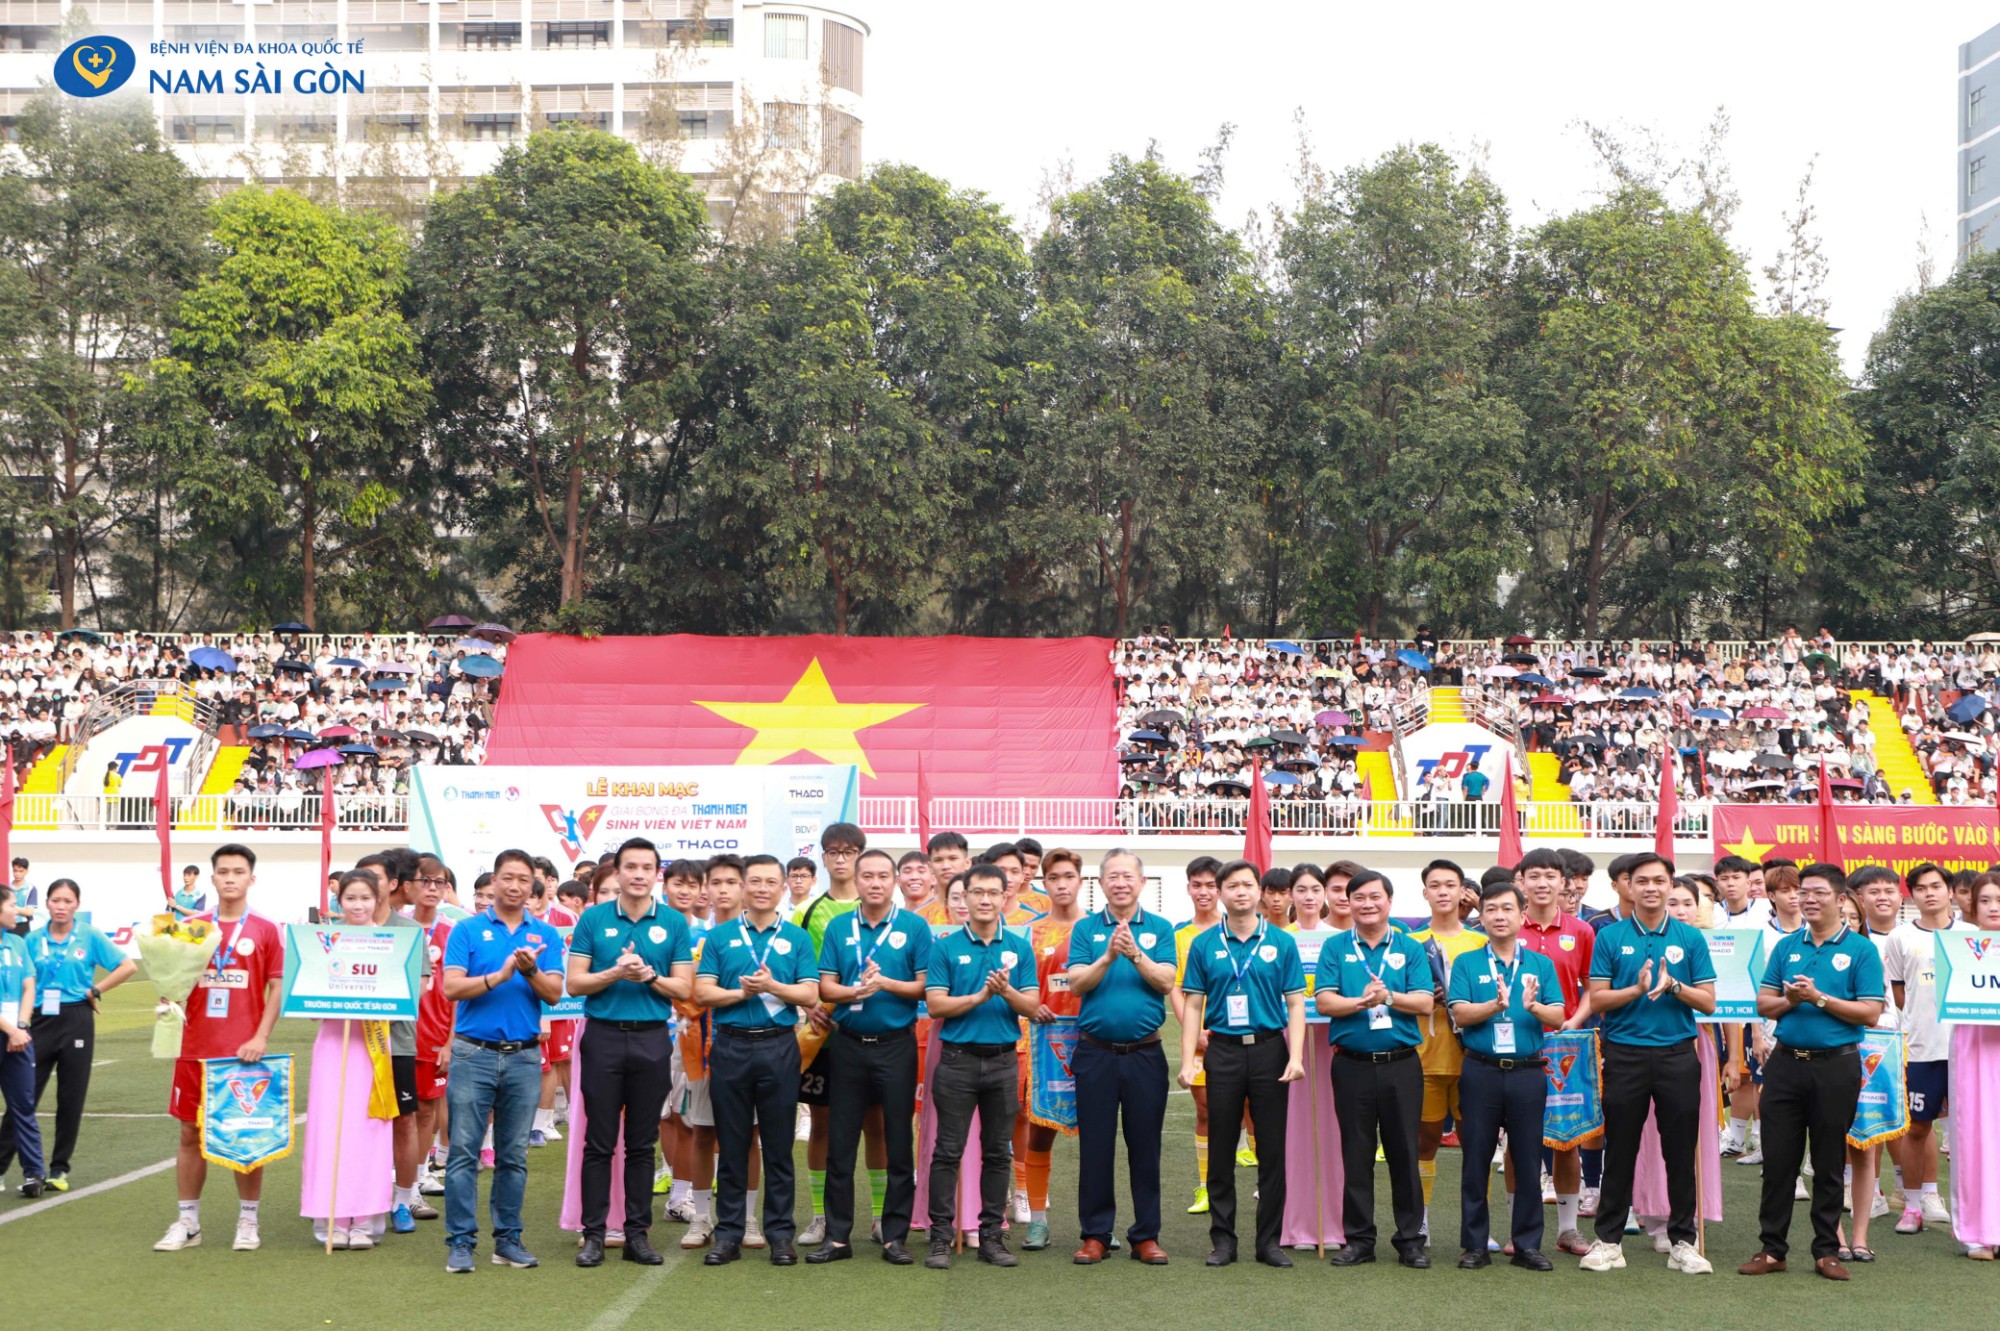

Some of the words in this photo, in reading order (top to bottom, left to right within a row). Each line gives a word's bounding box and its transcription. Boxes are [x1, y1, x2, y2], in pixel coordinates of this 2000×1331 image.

[587, 777, 608, 797] LỄ
[612, 783, 655, 797] KHAI
[659, 783, 699, 800] MẠC
[789, 789, 824, 798] THACO
[692, 804, 724, 815] THANH
[606, 820, 640, 830] SINH
[644, 817, 677, 830] VIÊN
[715, 819, 748, 830] NAM
[795, 825, 812, 834] BIDV
[1776, 825, 1811, 844] UTH
[1852, 820, 1898, 845] SÀNG
[1901, 820, 1949, 846] BƯỚC
[1953, 820, 1988, 846] VÀO
[677, 840, 739, 850] THACO
[351, 964, 378, 976] SIU
[203, 974, 244, 983] THACO
[328, 983, 377, 992] University
[1737, 1006, 1754, 1014] HCM
[801, 1073, 825, 1095] 23
[1909, 1091, 1925, 1112] 15
